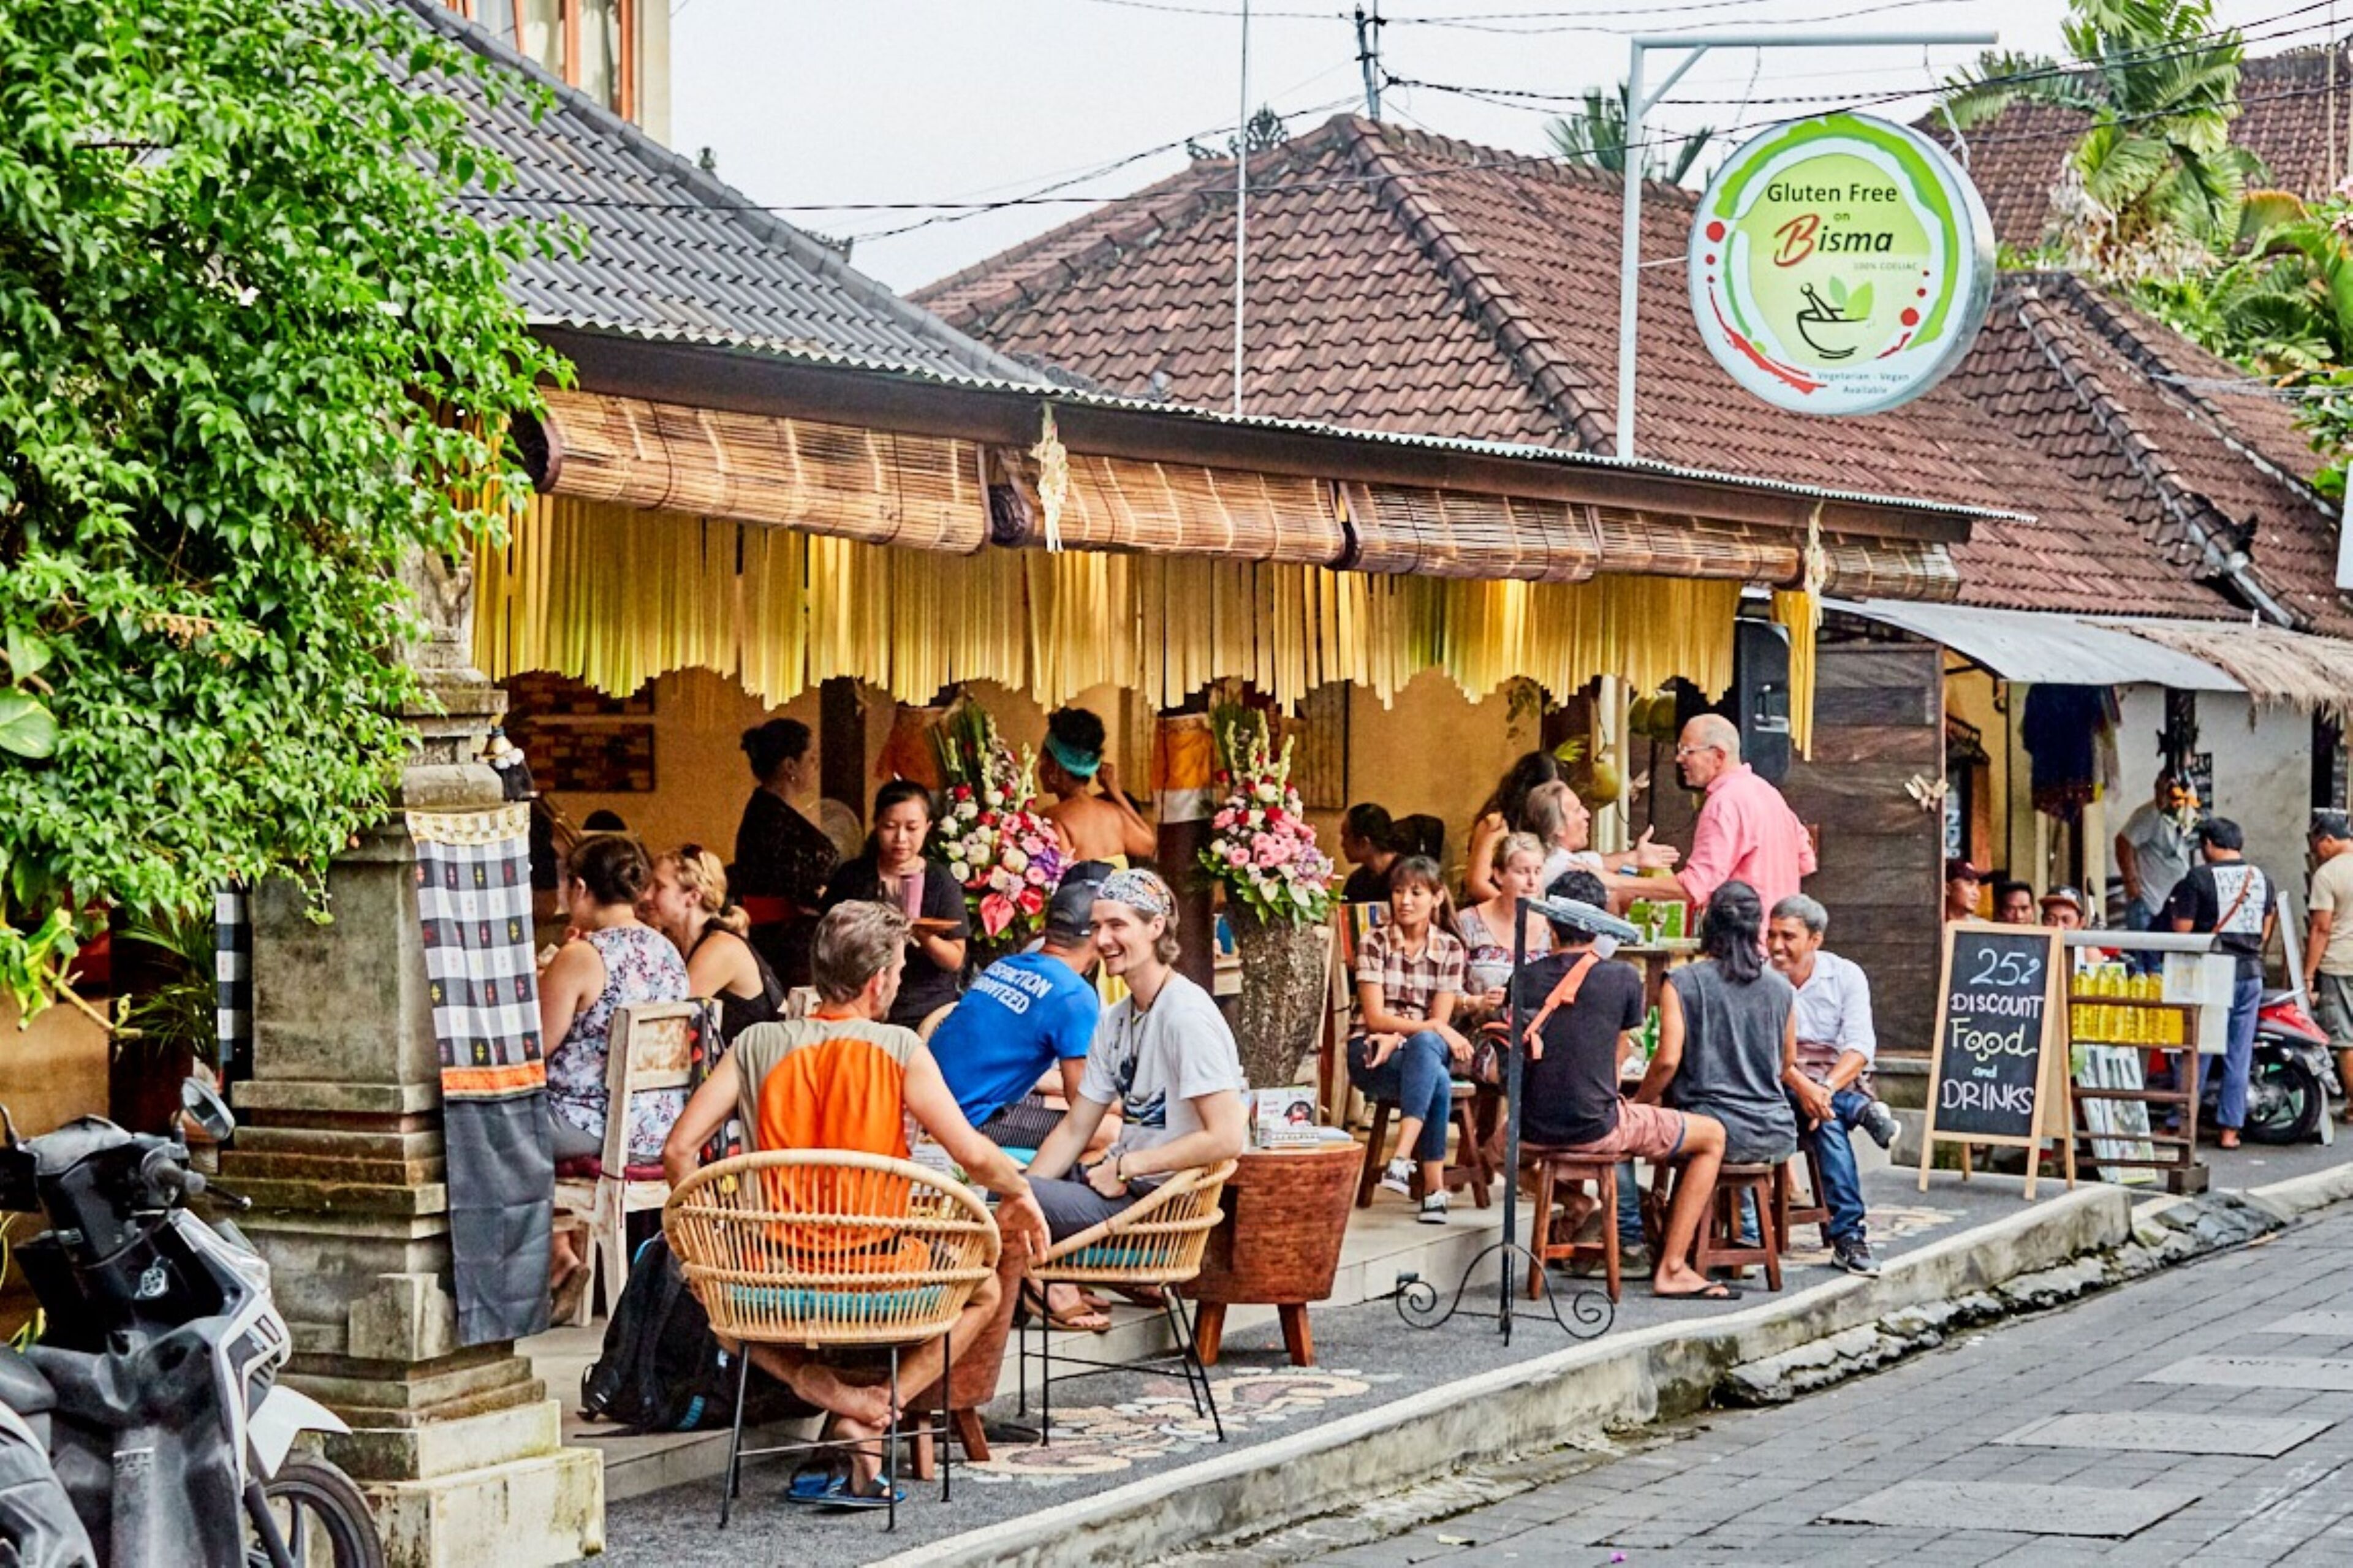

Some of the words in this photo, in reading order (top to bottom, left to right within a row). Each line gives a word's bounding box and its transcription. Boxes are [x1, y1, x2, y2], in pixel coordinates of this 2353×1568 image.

[1767, 183, 1841, 202] Gluten
[1849, 184, 1898, 202] Free
[1833, 213, 1851, 221] on
[1773, 213, 1894, 268] Bisma
[1817, 372, 1870, 381] Vegetarian
[1879, 372, 1910, 382] Vegan
[1843, 385, 1887, 394] Available
[1949, 993, 2045, 1019] DISCOUNT
[1949, 1017, 2039, 1058] Food
[1971, 1064, 1998, 1078] and
[1941, 1078, 2035, 1115] DRINKS
